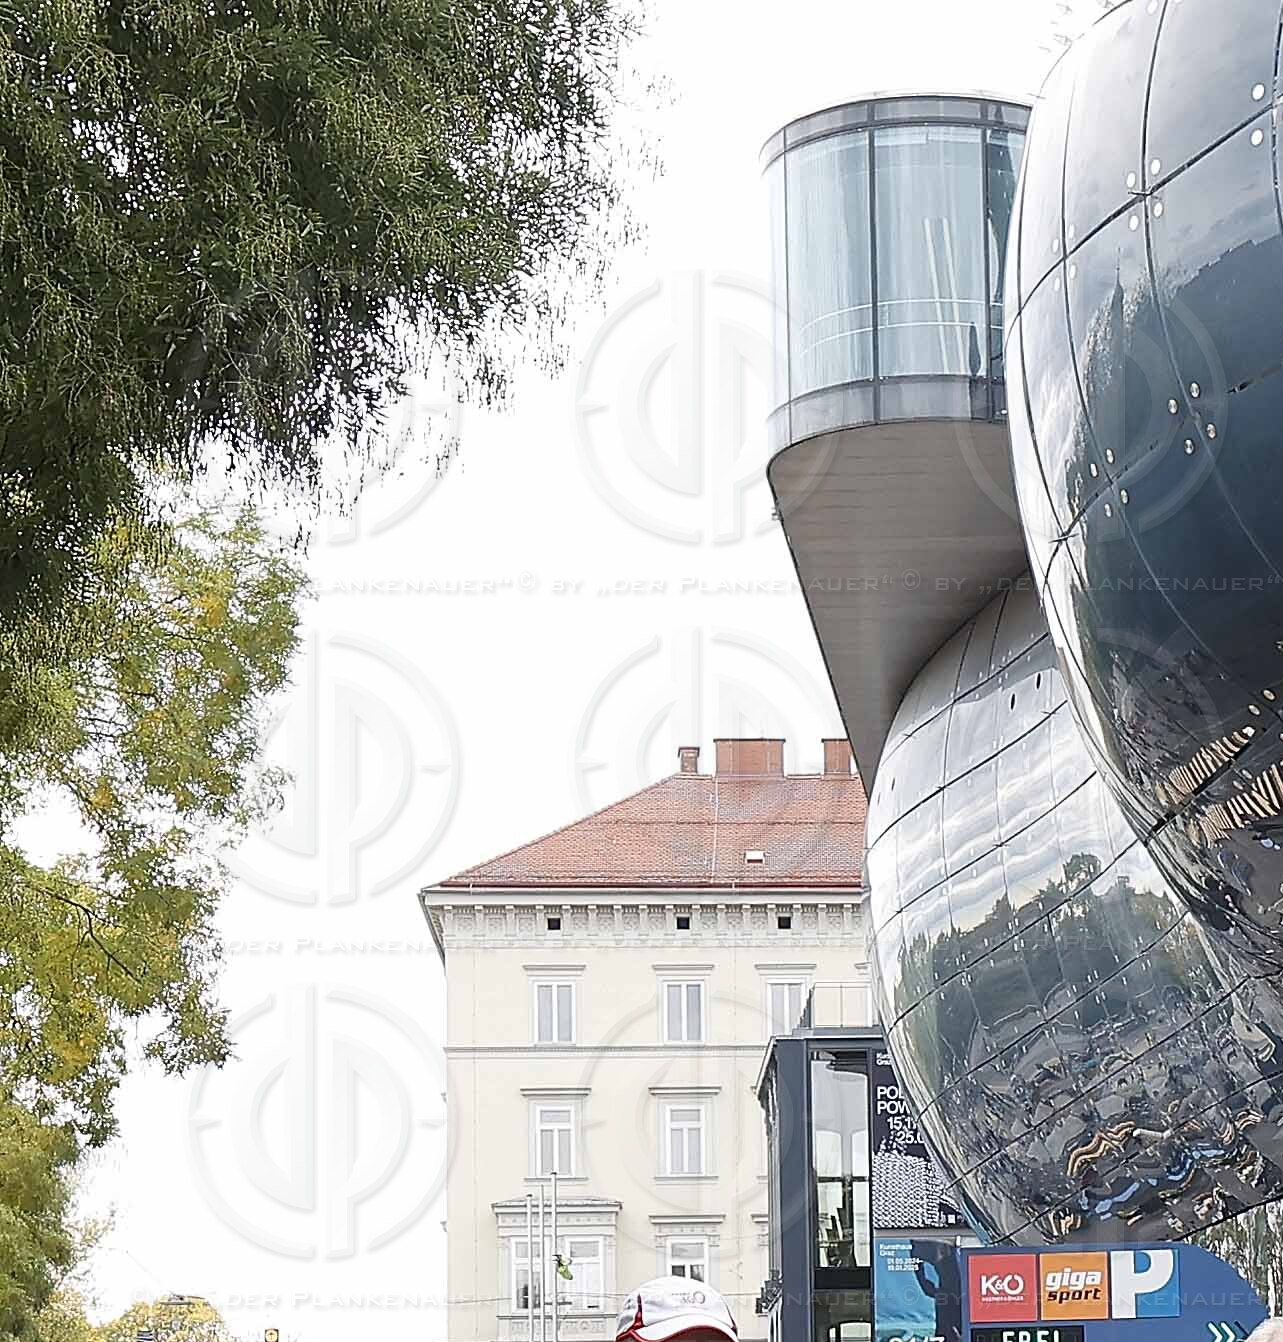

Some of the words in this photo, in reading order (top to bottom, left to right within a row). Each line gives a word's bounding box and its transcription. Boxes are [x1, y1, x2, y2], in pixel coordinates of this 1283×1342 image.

[981, 1274, 1024, 1296] K&O
[1045, 1268, 1103, 1291] giga
[1111, 1250, 1174, 1319] P
[1047, 1288, 1102, 1305] sport
